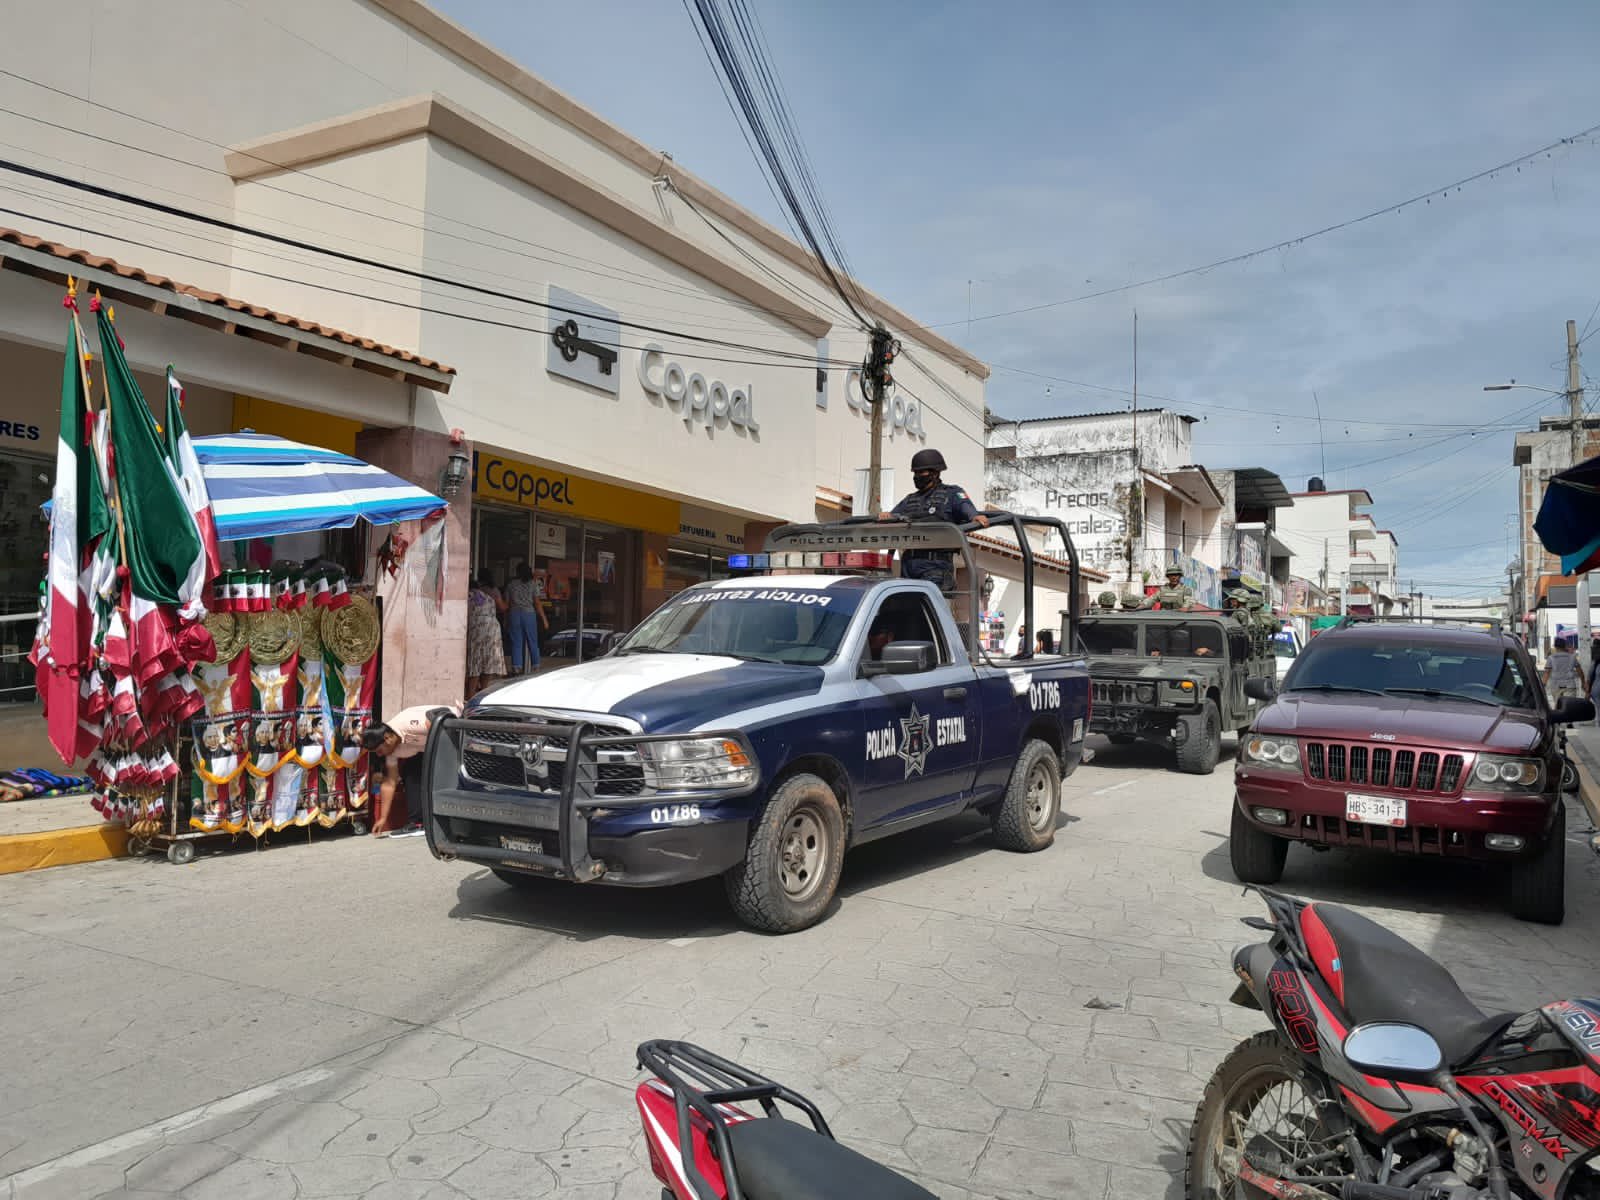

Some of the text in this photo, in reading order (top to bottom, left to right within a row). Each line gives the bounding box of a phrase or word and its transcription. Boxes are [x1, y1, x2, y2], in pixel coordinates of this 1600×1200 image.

[640, 342, 760, 428] Coppel
[486, 460, 574, 505] Coppel
[1045, 489, 1109, 508] Precios
[860, 535, 931, 543] ESTATAL
[1030, 680, 1060, 711] 01786
[866, 716, 966, 761] POLICÍA ESTATAL
[1370, 732, 1396, 741] Jeep
[650, 803, 701, 824] 01786
